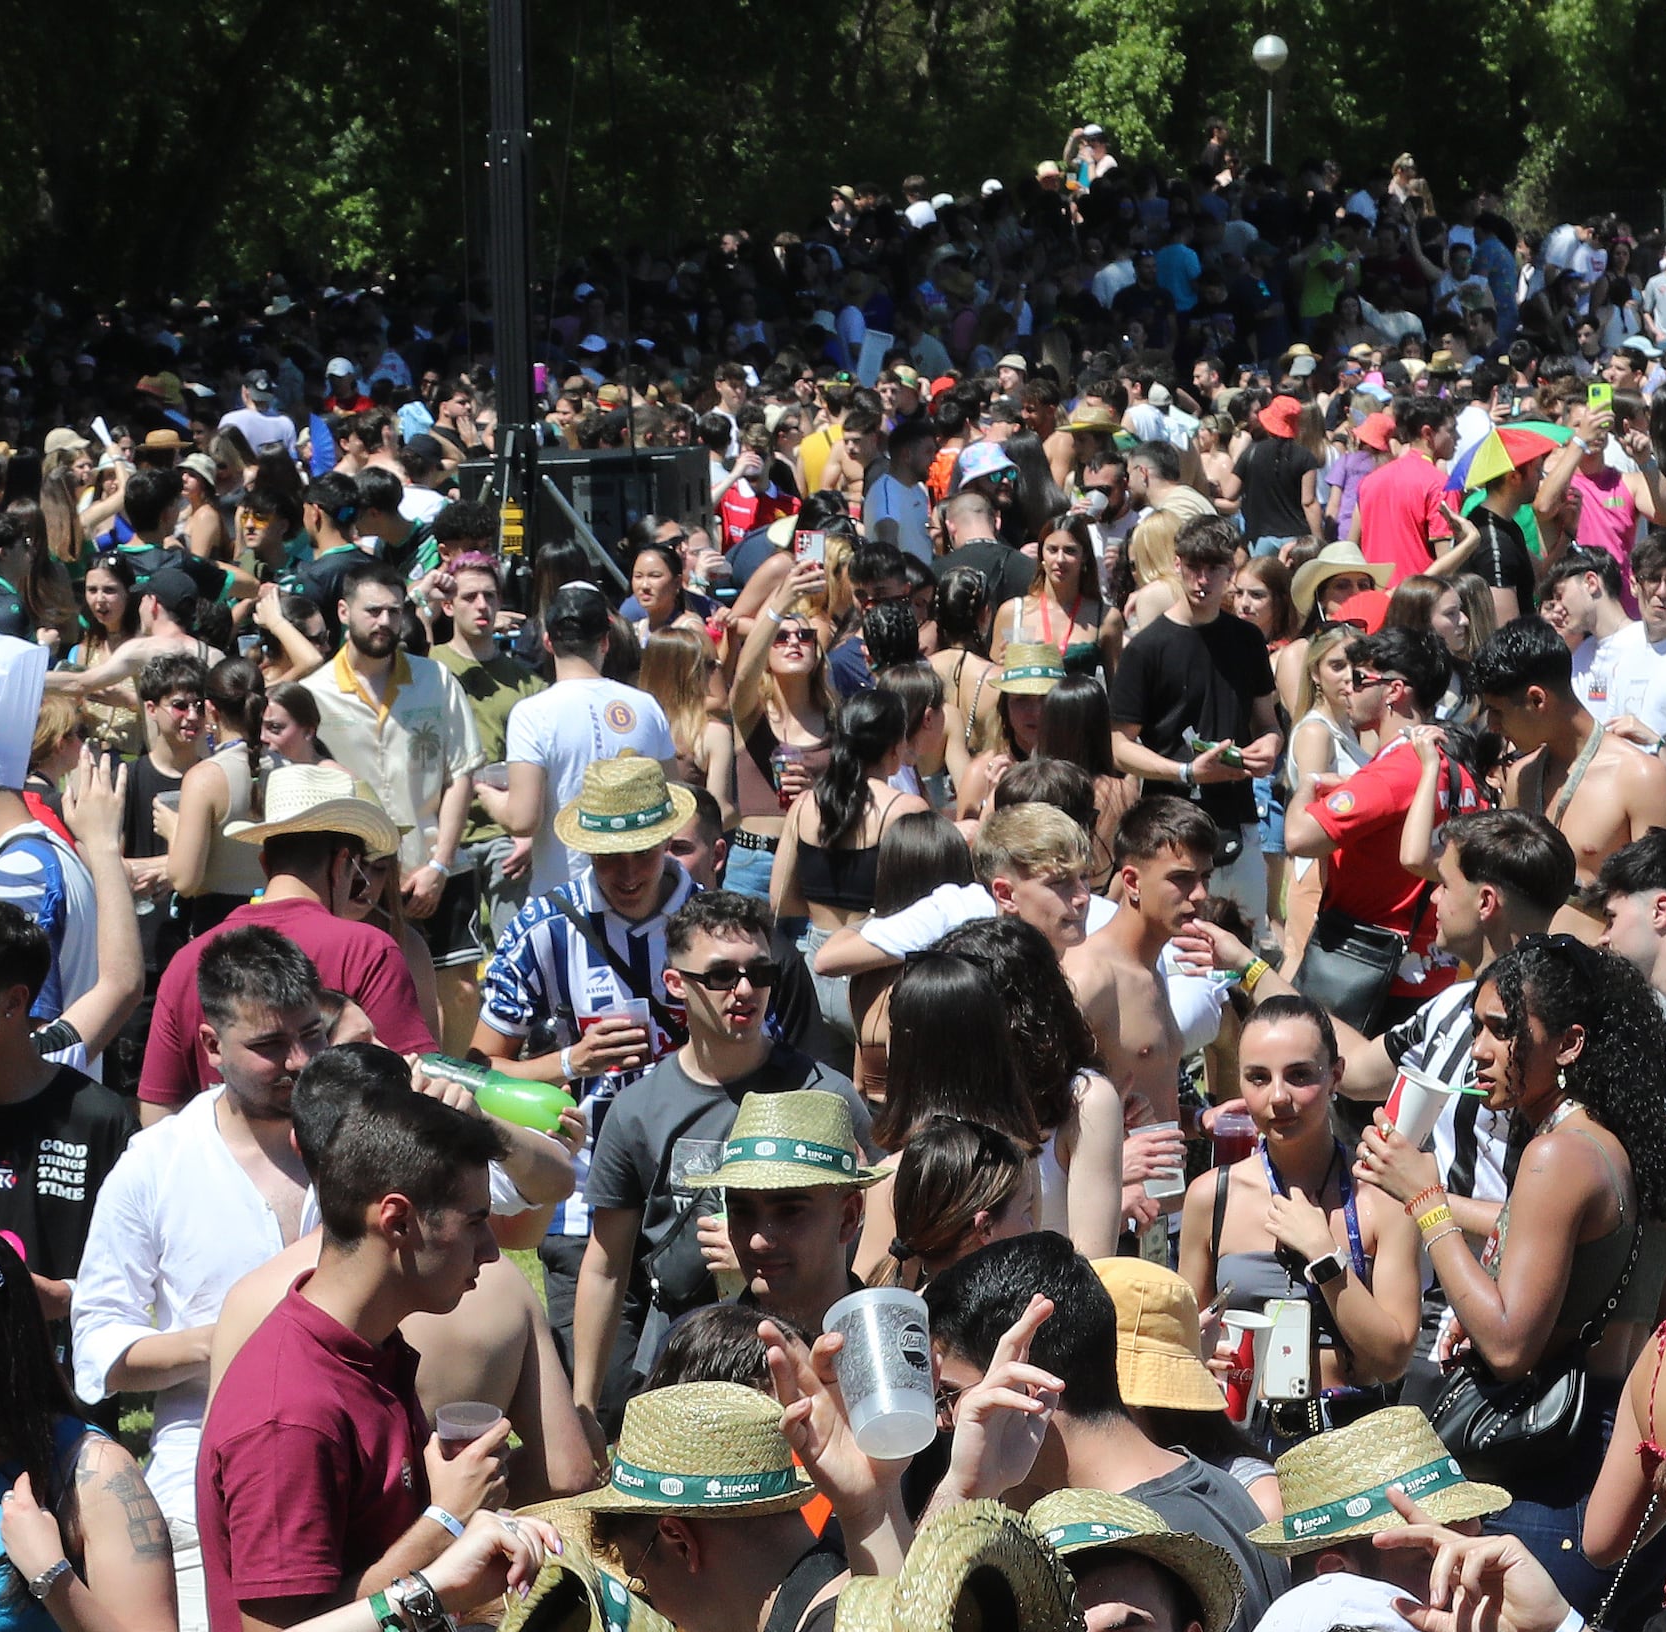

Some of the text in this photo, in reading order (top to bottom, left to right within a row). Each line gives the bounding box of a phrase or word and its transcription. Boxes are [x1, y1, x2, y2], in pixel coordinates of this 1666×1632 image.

[613, 706, 628, 725] 6
[39, 1138, 88, 1158] GOOD
[37, 1154, 88, 1171] THINGS
[37, 1166, 85, 1185] TAKE
[36, 1180, 85, 1202] TIME
[721, 1481, 761, 1494] SIPCAM
[1303, 1514, 1331, 1528] SIPCAM
[1406, 1472, 1440, 1490] SIPCAM
